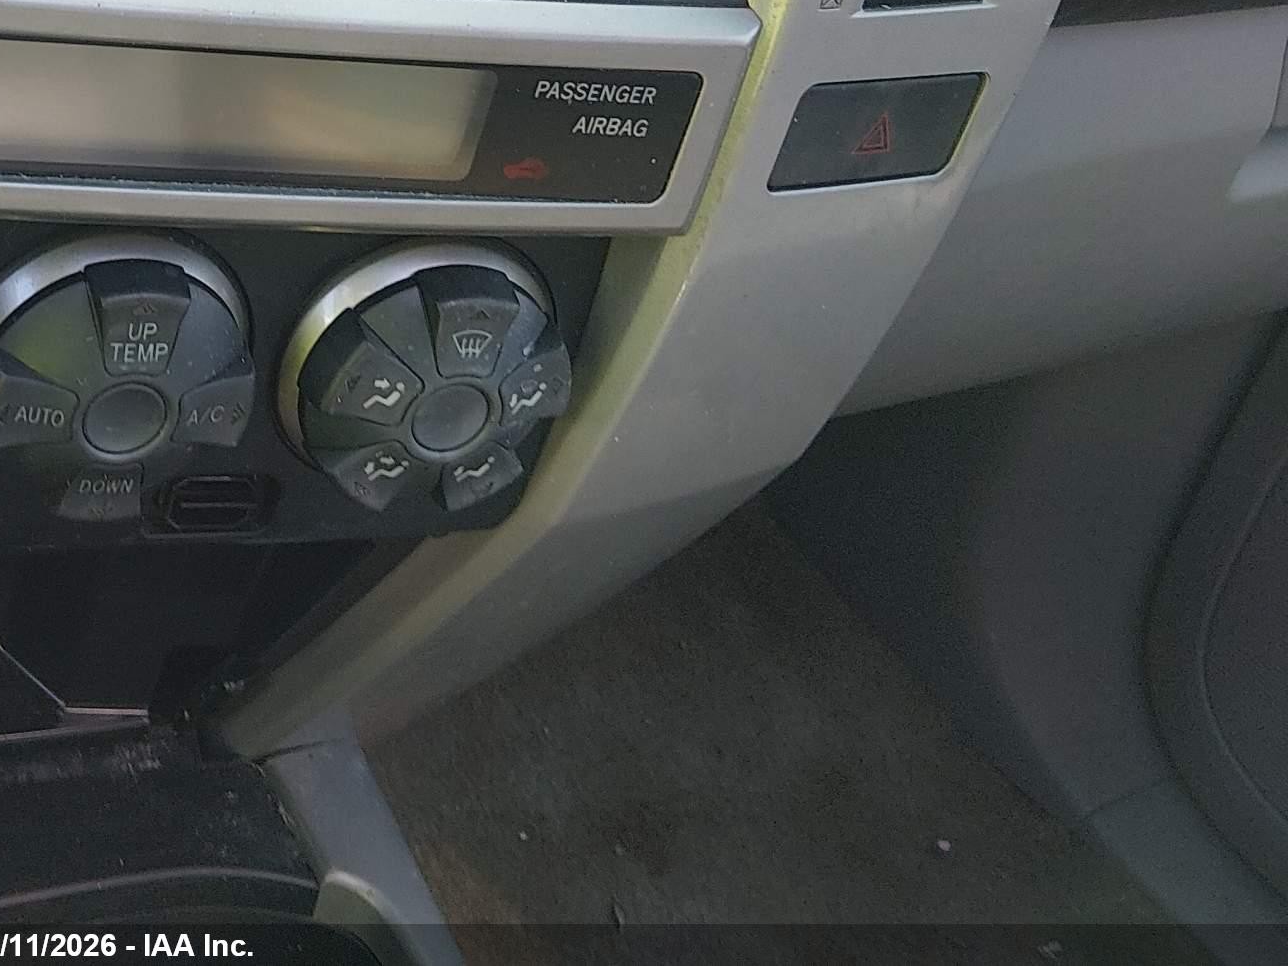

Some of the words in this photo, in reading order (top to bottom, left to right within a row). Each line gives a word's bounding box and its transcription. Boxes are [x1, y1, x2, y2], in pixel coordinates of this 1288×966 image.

[534, 80, 657, 105] PASSENGER
[571, 115, 650, 138] AIRBAG
[127, 322, 158, 342] UP
[110, 341, 169, 364] TEMP
[13, 405, 65, 427] AUTO
[186, 404, 225, 427] A/C
[78, 478, 134, 494] DOWN
